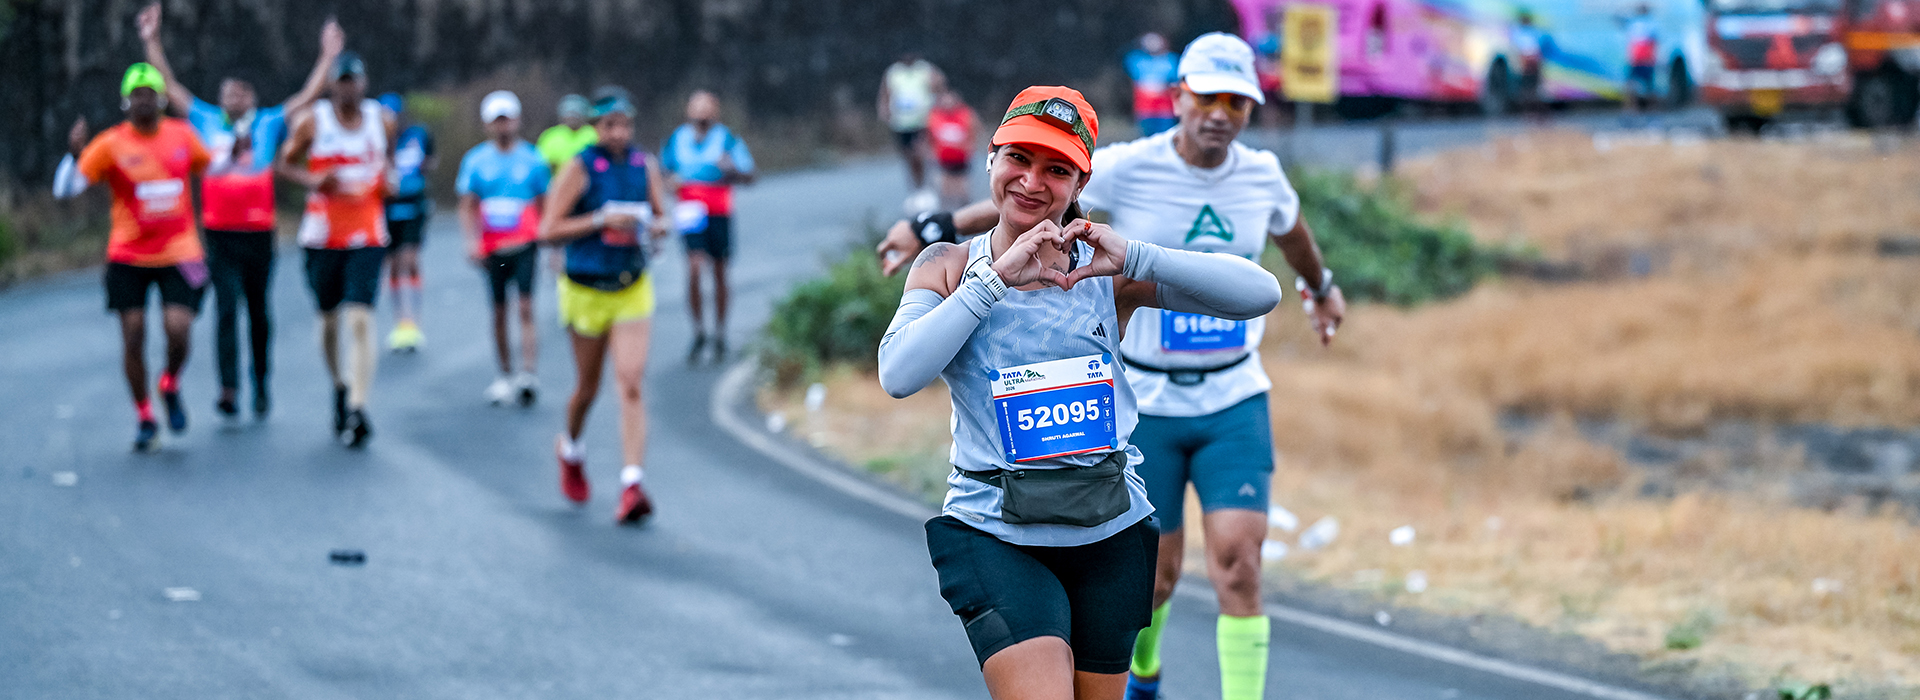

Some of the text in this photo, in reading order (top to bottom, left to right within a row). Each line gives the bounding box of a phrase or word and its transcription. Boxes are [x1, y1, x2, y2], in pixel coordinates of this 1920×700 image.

[1002, 371, 1022, 379] TATA
[1087, 371, 1104, 379] TATA
[1004, 378, 1024, 386] ULTRA
[1018, 399, 1099, 430] 52095
[1041, 434, 1061, 442] SHRUTI
